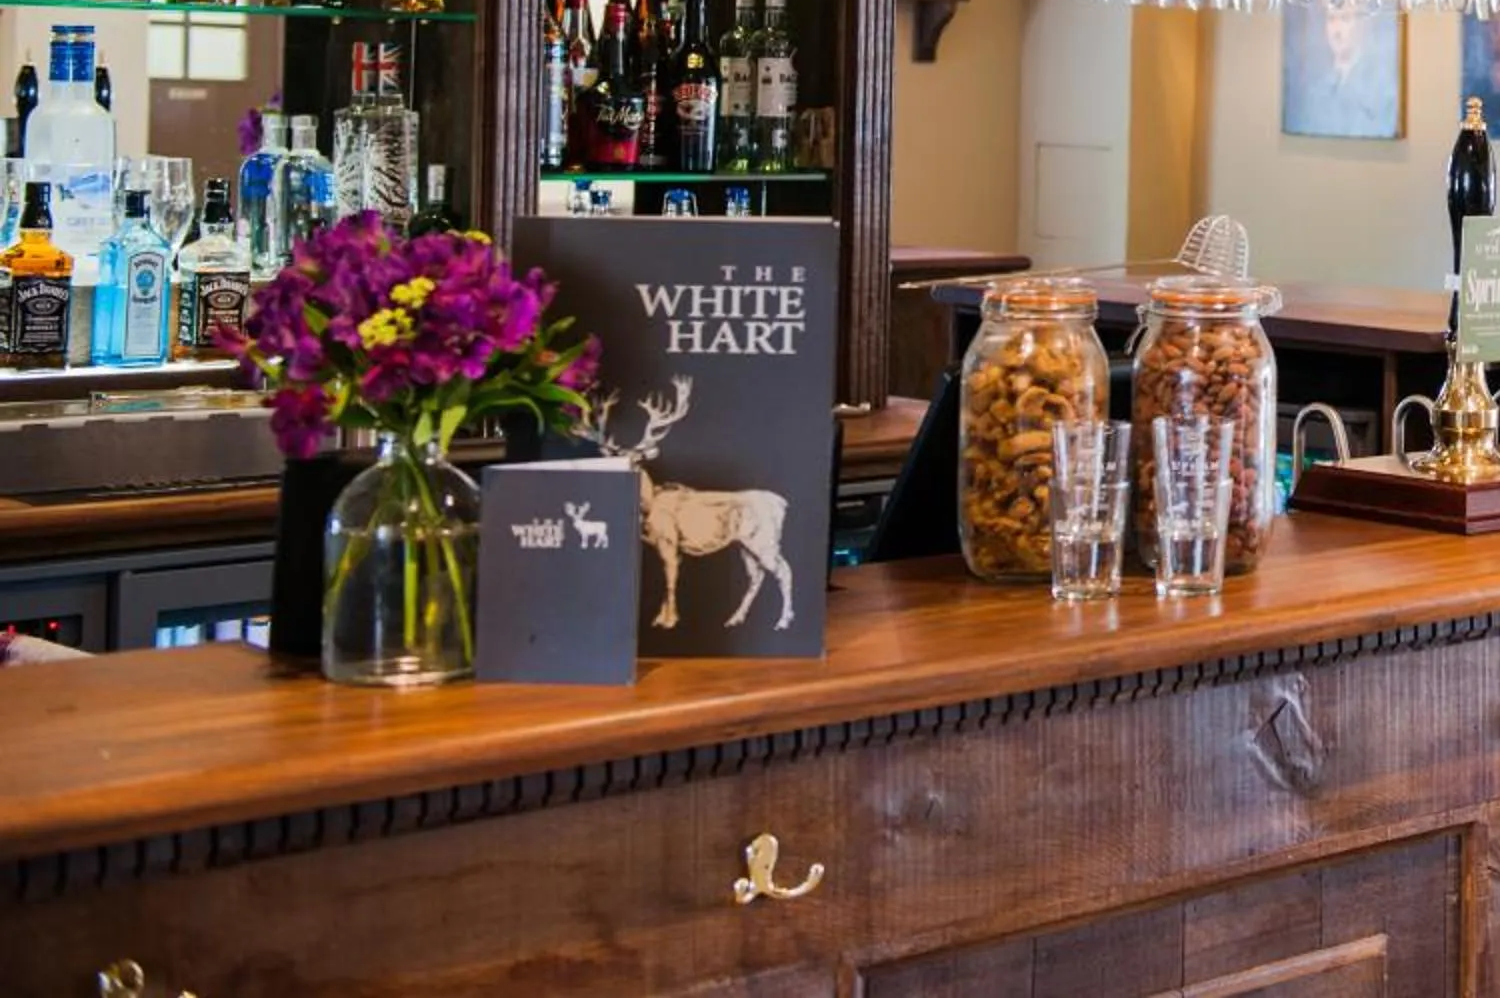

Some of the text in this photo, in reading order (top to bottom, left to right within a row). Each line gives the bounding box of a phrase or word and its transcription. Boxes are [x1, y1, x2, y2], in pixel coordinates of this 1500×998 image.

[719, 264, 807, 283] THE
[634, 283, 806, 319] WHITE
[666, 320, 805, 355] HART
[520, 535, 562, 548] HART
